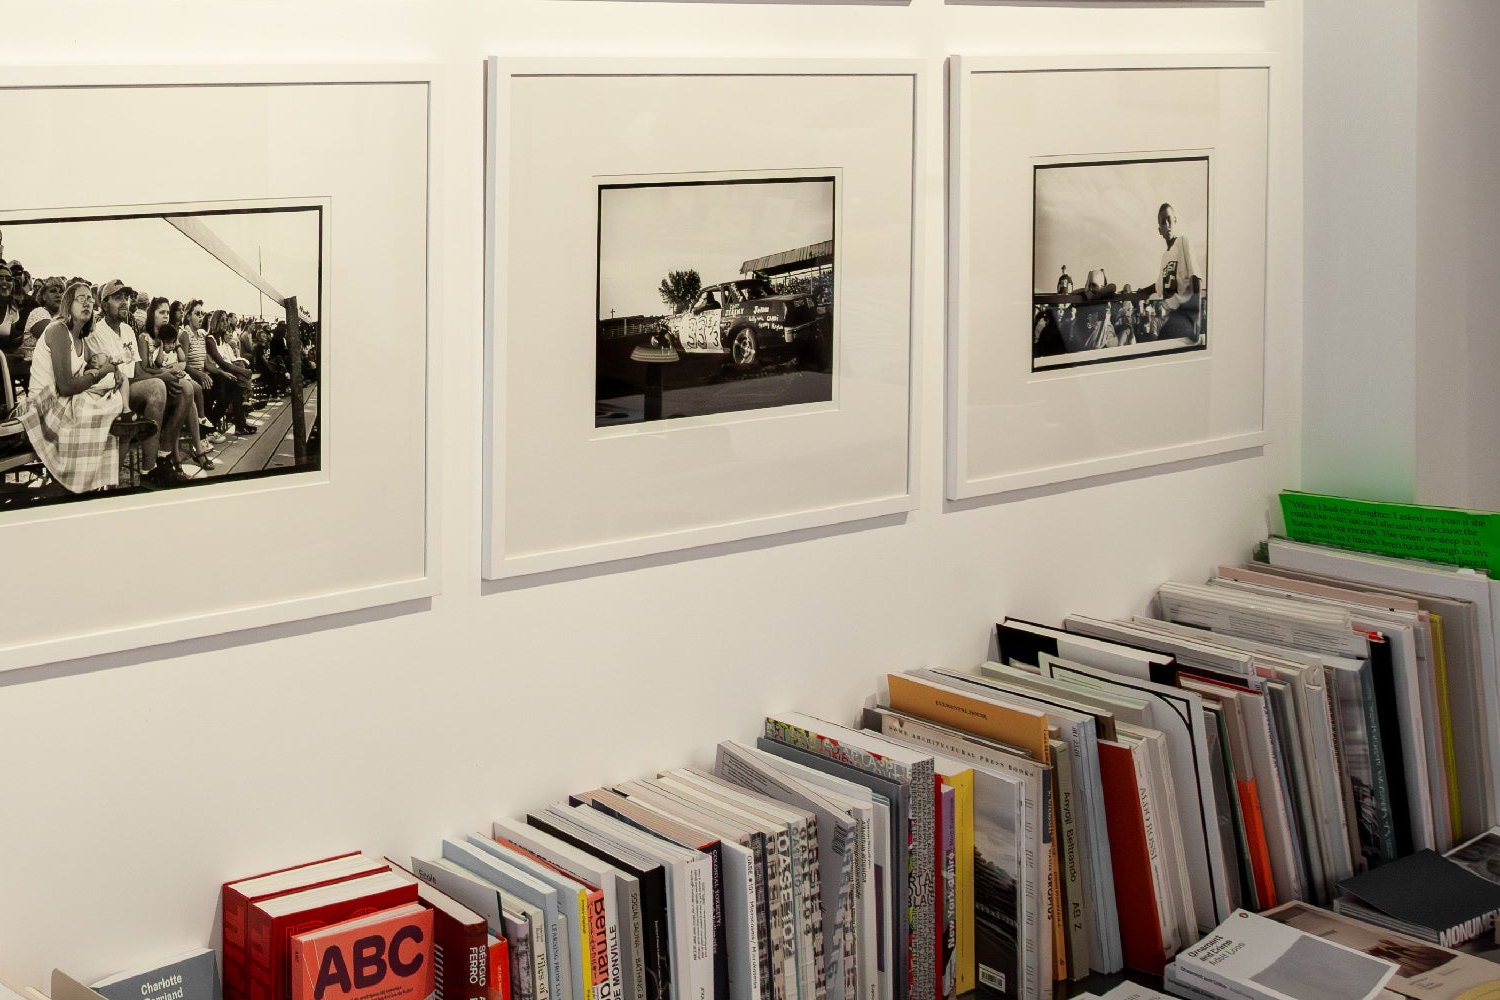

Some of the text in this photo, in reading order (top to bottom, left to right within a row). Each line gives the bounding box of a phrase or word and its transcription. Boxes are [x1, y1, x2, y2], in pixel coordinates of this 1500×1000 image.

[1291, 510, 1312, 518] could
[1363, 519, 1378, 527] and
[1396, 523, 1412, 531] said
[1427, 526, 1461, 535] because
[1464, 528, 1478, 536] the
[1292, 501, 1316, 510] When
[1324, 503, 1338, 512] had
[1399, 513, 1422, 522] asked
[1471, 519, 1485, 527] she
[1291, 520, 1314, 528] house
[1439, 536, 1460, 546] sleep
[1427, 547, 1460, 556] enough
[1473, 549, 1489, 557] live
[778, 835, 793, 903] OASE
[947, 889, 955, 918] York
[551, 924, 559, 960] LEARNING
[631, 893, 639, 920] SOCIAL
[635, 958, 644, 992] BATHING
[947, 920, 955, 949] New
[313, 925, 424, 1000] ABC
[469, 947, 478, 984] FERRO
[609, 925, 620, 987] MONVILLE
[141, 974, 183, 996] Charlotte
